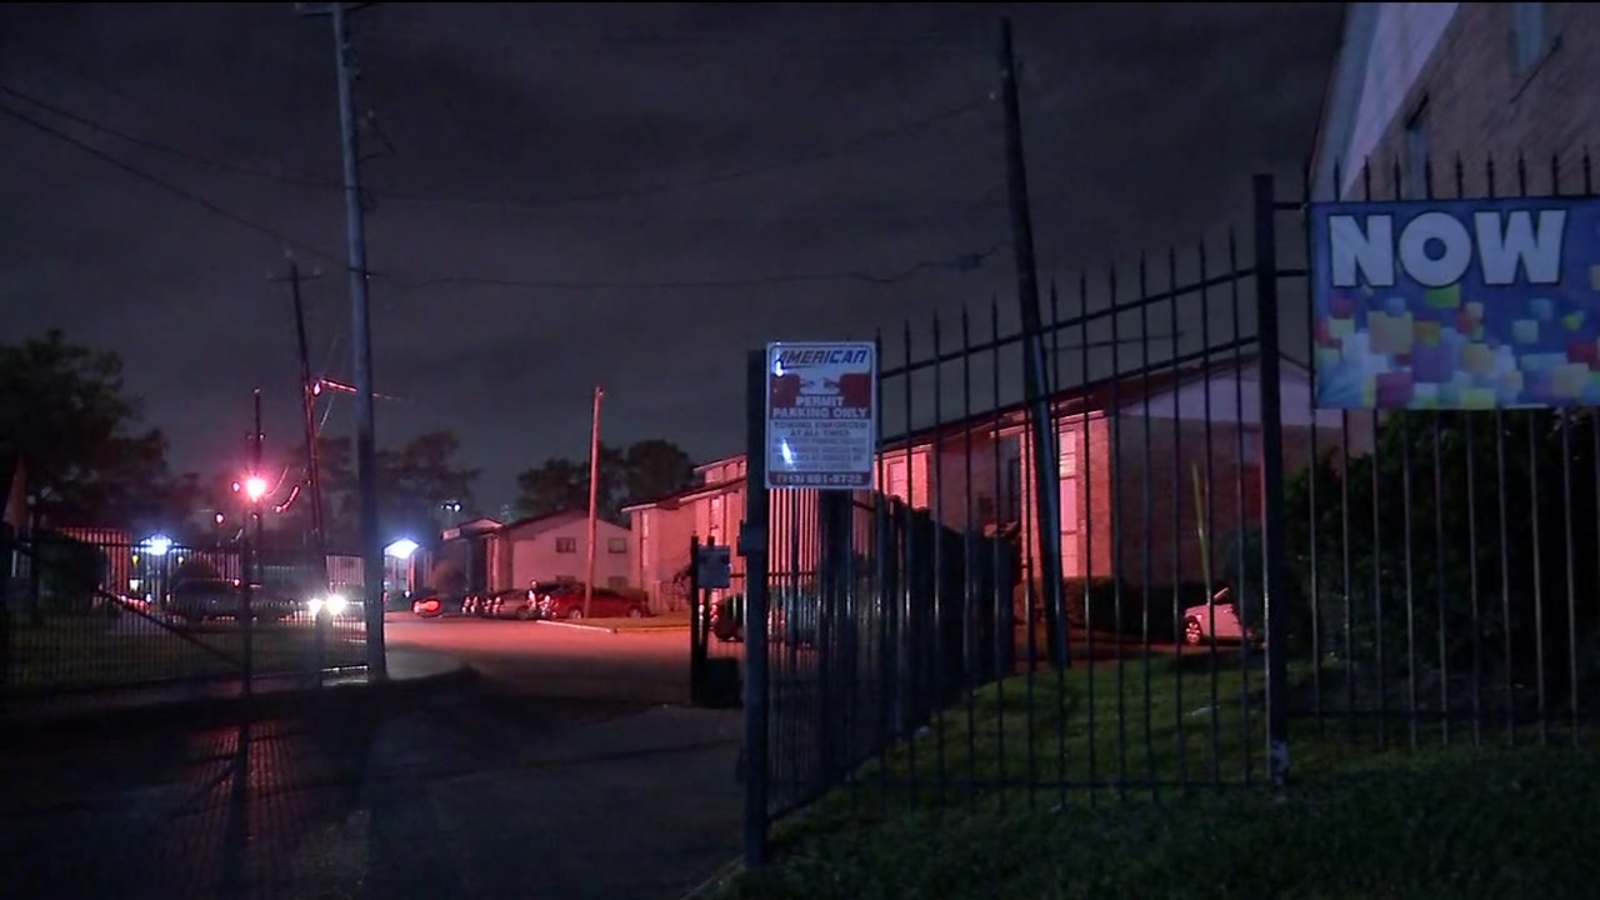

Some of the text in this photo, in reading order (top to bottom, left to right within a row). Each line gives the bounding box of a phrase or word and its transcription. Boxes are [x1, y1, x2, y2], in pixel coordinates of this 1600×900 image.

[1329, 210, 1567, 287] NOW
[775, 350, 867, 366] AMERICAN
[796, 396, 844, 407] PERMIT
[772, 408, 867, 418] PARKING ONLY
[815, 421, 867, 429] ENFORCED
[822, 429, 850, 437] TIMES
